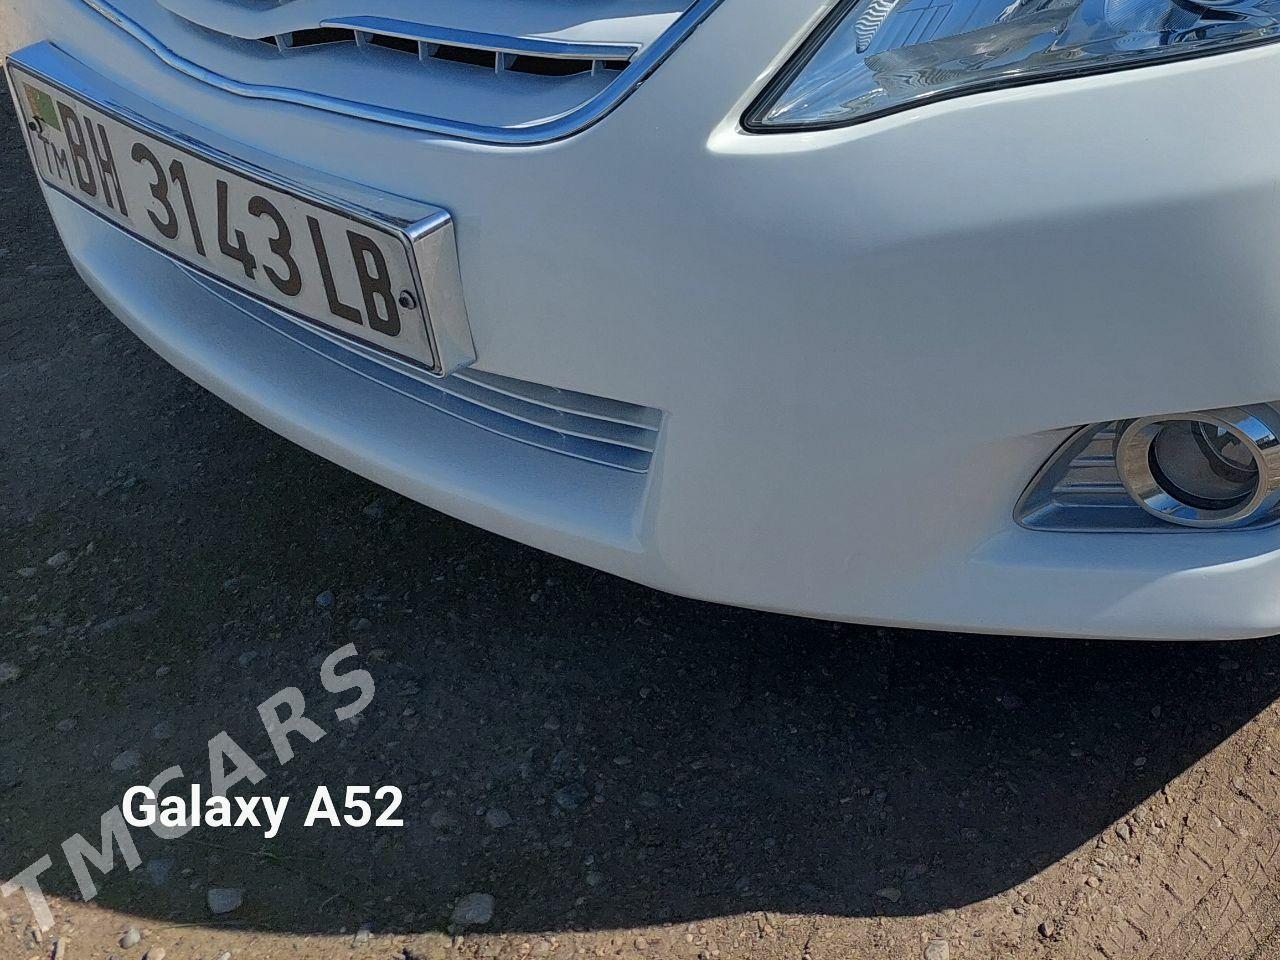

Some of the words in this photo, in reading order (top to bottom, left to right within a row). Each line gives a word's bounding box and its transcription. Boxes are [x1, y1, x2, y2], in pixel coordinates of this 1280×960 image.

[37, 133, 74, 187] TM
[56, 100, 128, 216] BH
[131, 142, 302, 297] 3143
[306, 215, 402, 337] LB
